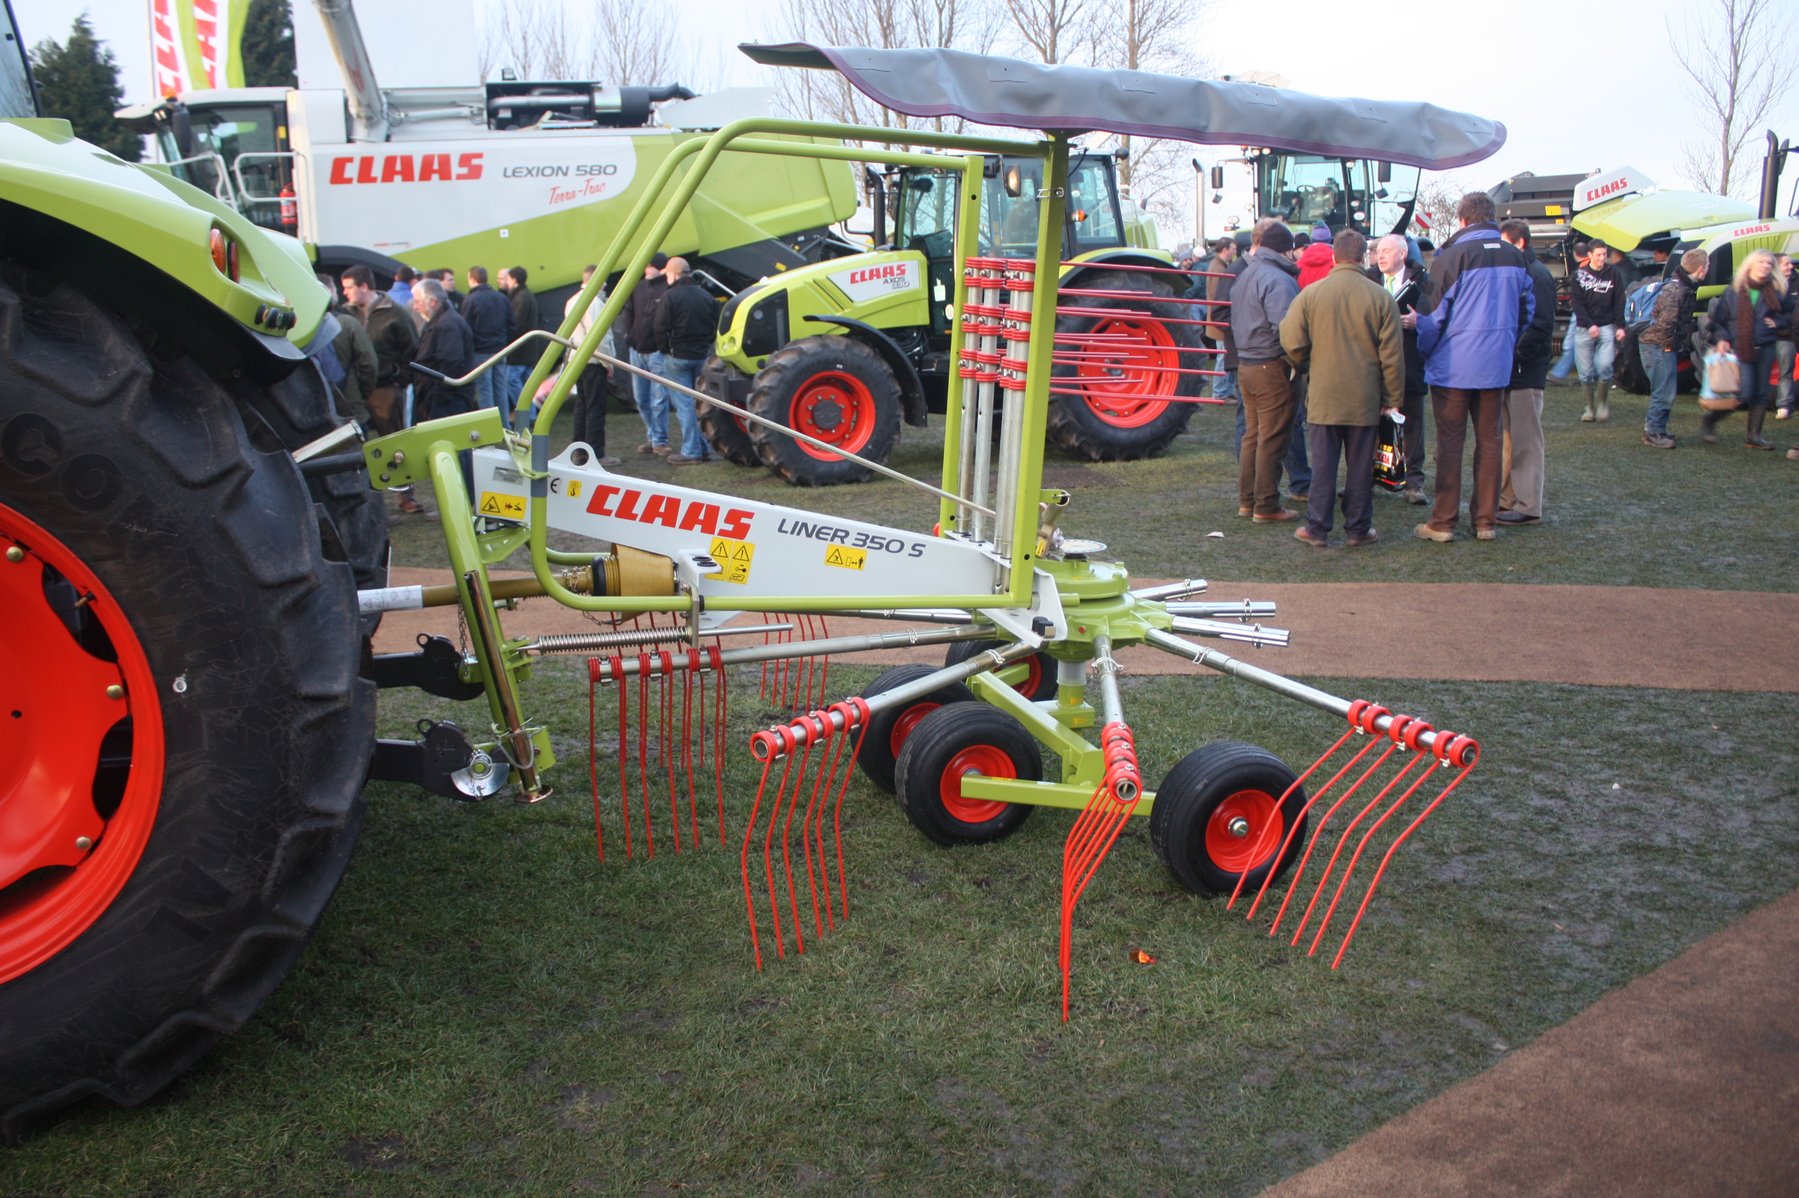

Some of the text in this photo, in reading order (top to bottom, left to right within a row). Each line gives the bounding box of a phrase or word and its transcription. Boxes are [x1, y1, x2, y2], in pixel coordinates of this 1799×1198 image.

[330, 152, 484, 184] CLAAS
[502, 164, 618, 178] LEXION 580
[549, 177, 607, 205] Terra-Trac
[1586, 177, 1628, 202] CLAAS
[1733, 224, 1771, 237] CLAAS
[850, 264, 906, 284] CLAAS
[883, 276, 906, 285] AXOS
[586, 484, 755, 540] CLAAS
[777, 518, 926, 558] LINER 350 S
